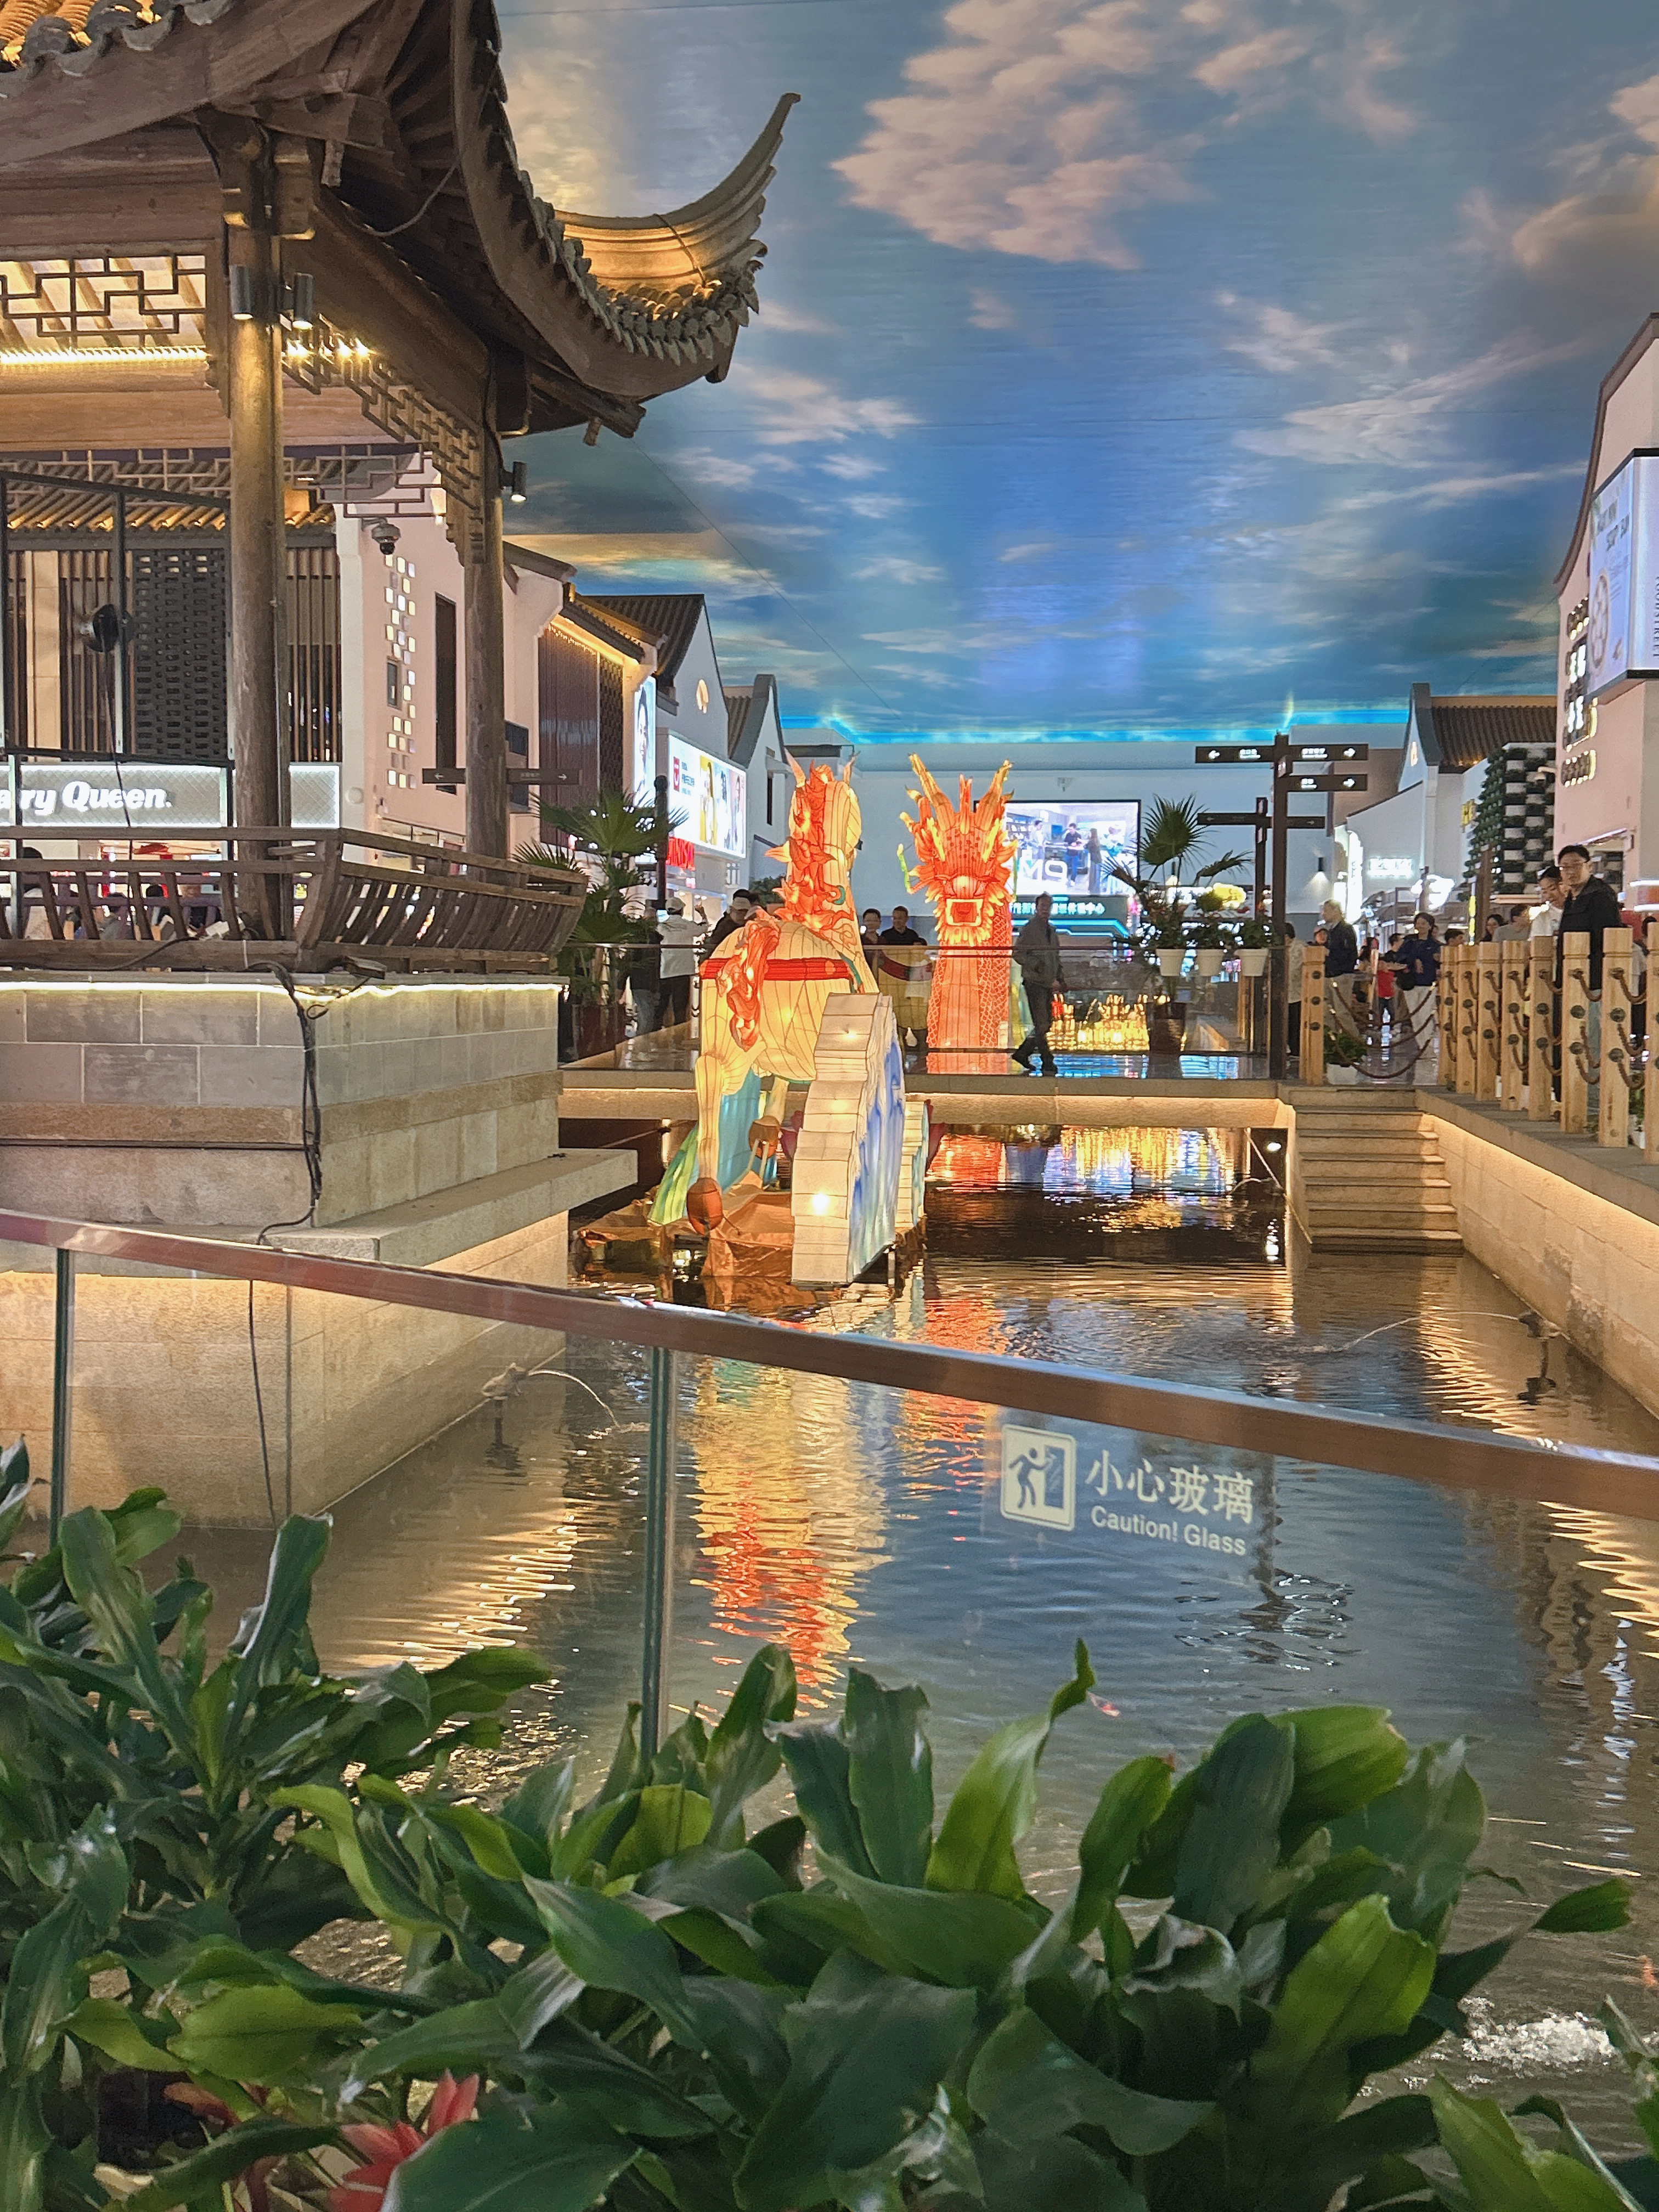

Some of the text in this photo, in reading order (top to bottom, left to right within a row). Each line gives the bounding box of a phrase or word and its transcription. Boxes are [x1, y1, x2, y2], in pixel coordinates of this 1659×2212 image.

[1086, 1449, 1254, 1524] 小心玻璃
[1091, 1505, 1247, 1556] Caution! Glass
